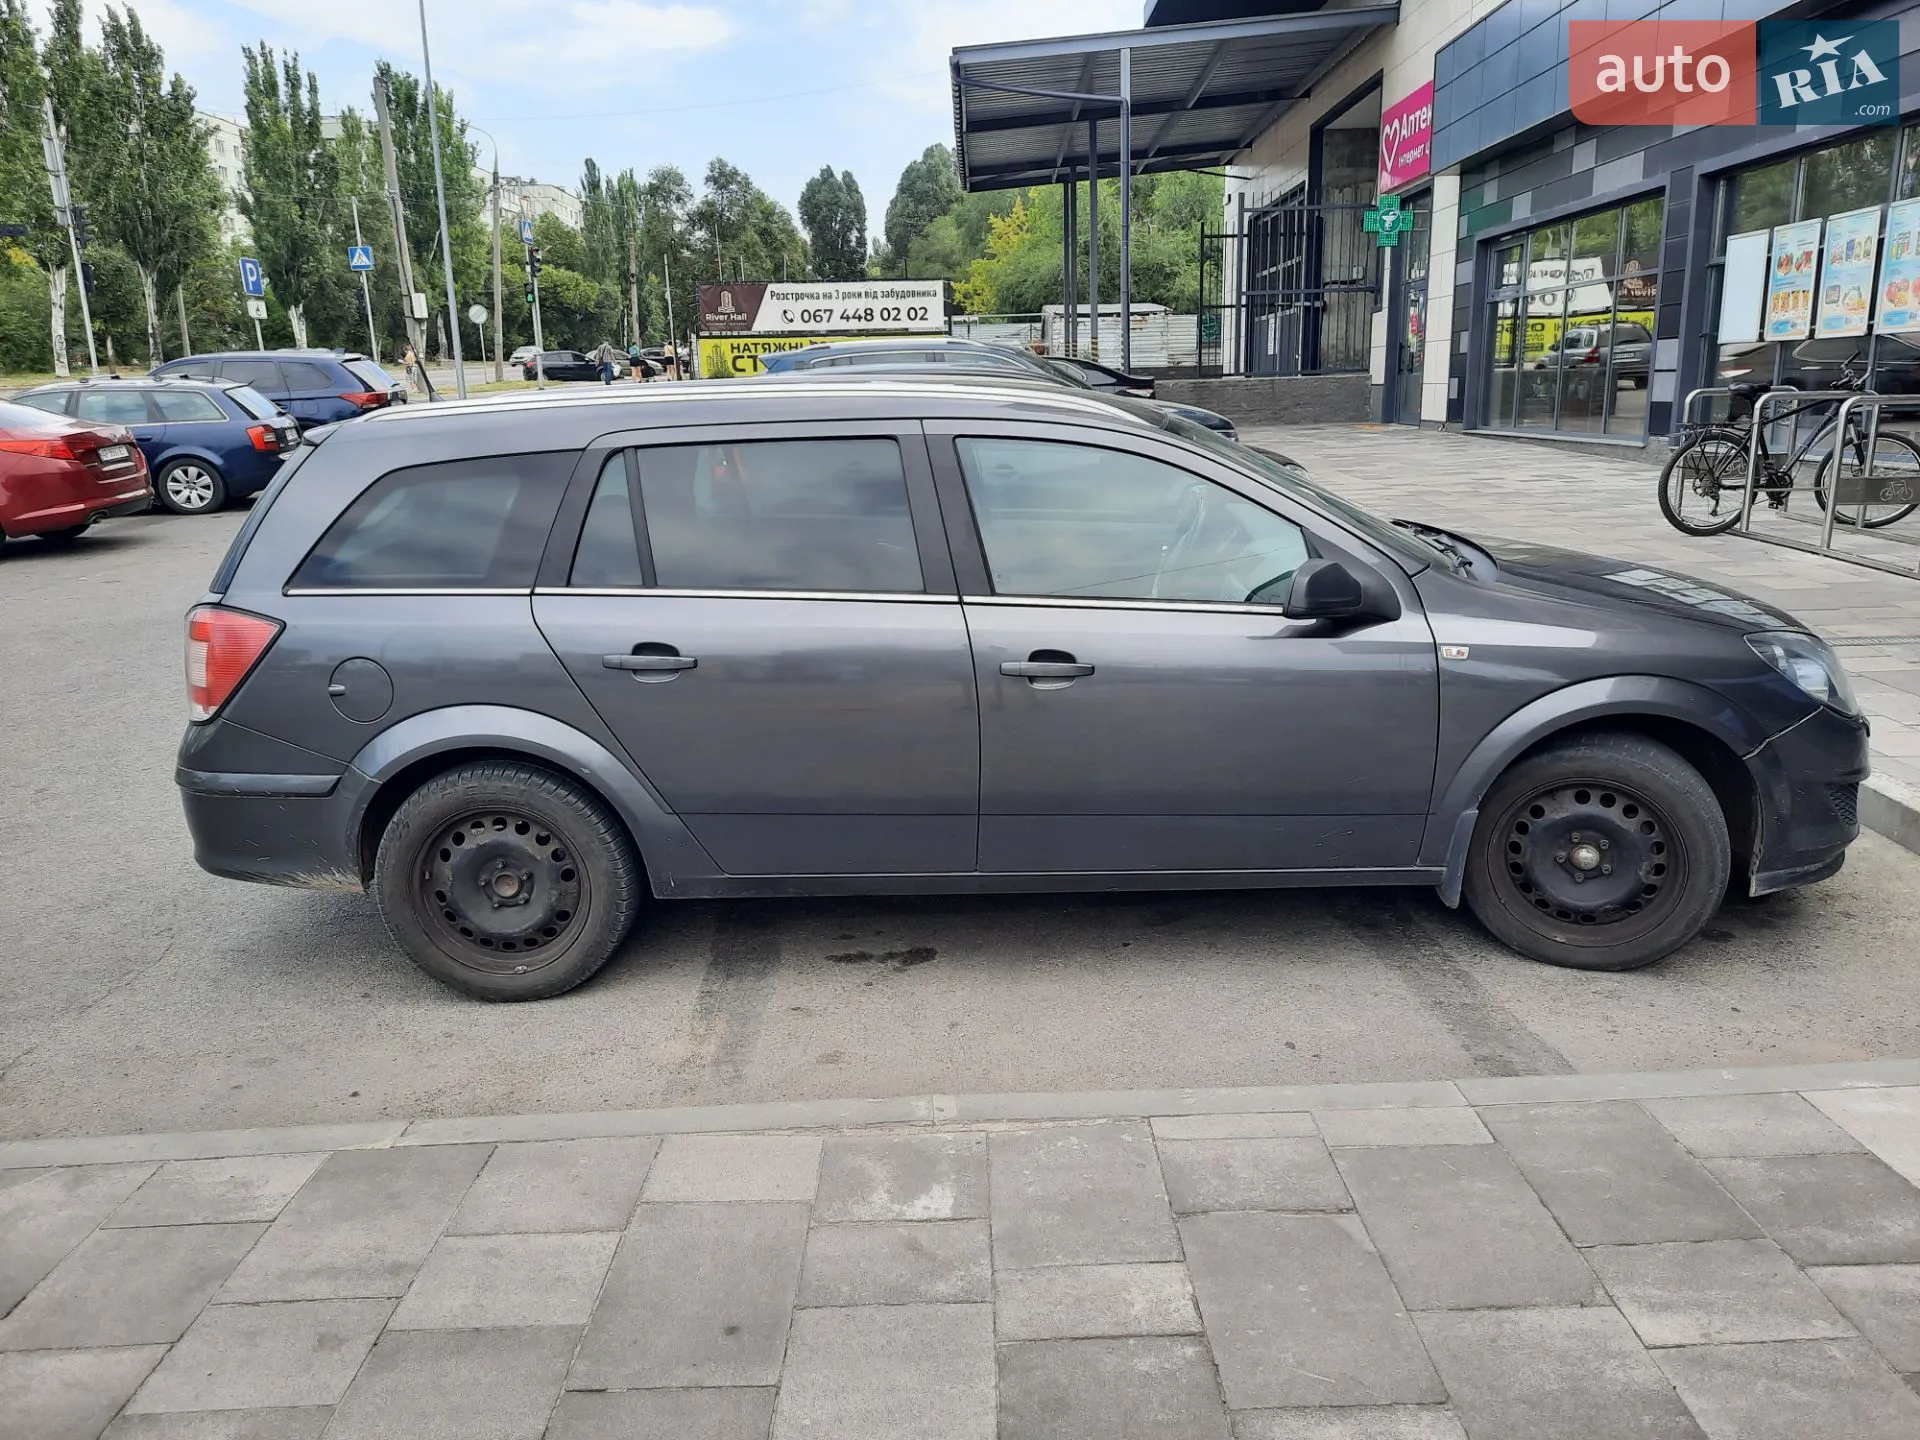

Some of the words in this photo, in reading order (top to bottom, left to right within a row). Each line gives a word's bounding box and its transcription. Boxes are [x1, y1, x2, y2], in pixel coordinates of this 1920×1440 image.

[246, 262, 258, 291] P
[770, 290, 820, 303] Розстрочка
[822, 291, 833, 301] на
[834, 289, 840, 300] 3
[842, 290, 863, 302] роки
[864, 288, 879, 300] від
[880, 288, 937, 300] забудовника
[705, 313, 728, 321] River
[731, 313, 747, 321] Hall
[800, 308, 834, 324] 067
[840, 307, 875, 323] 448
[880, 306, 902, 322] 02
[907, 306, 929, 321] 02
